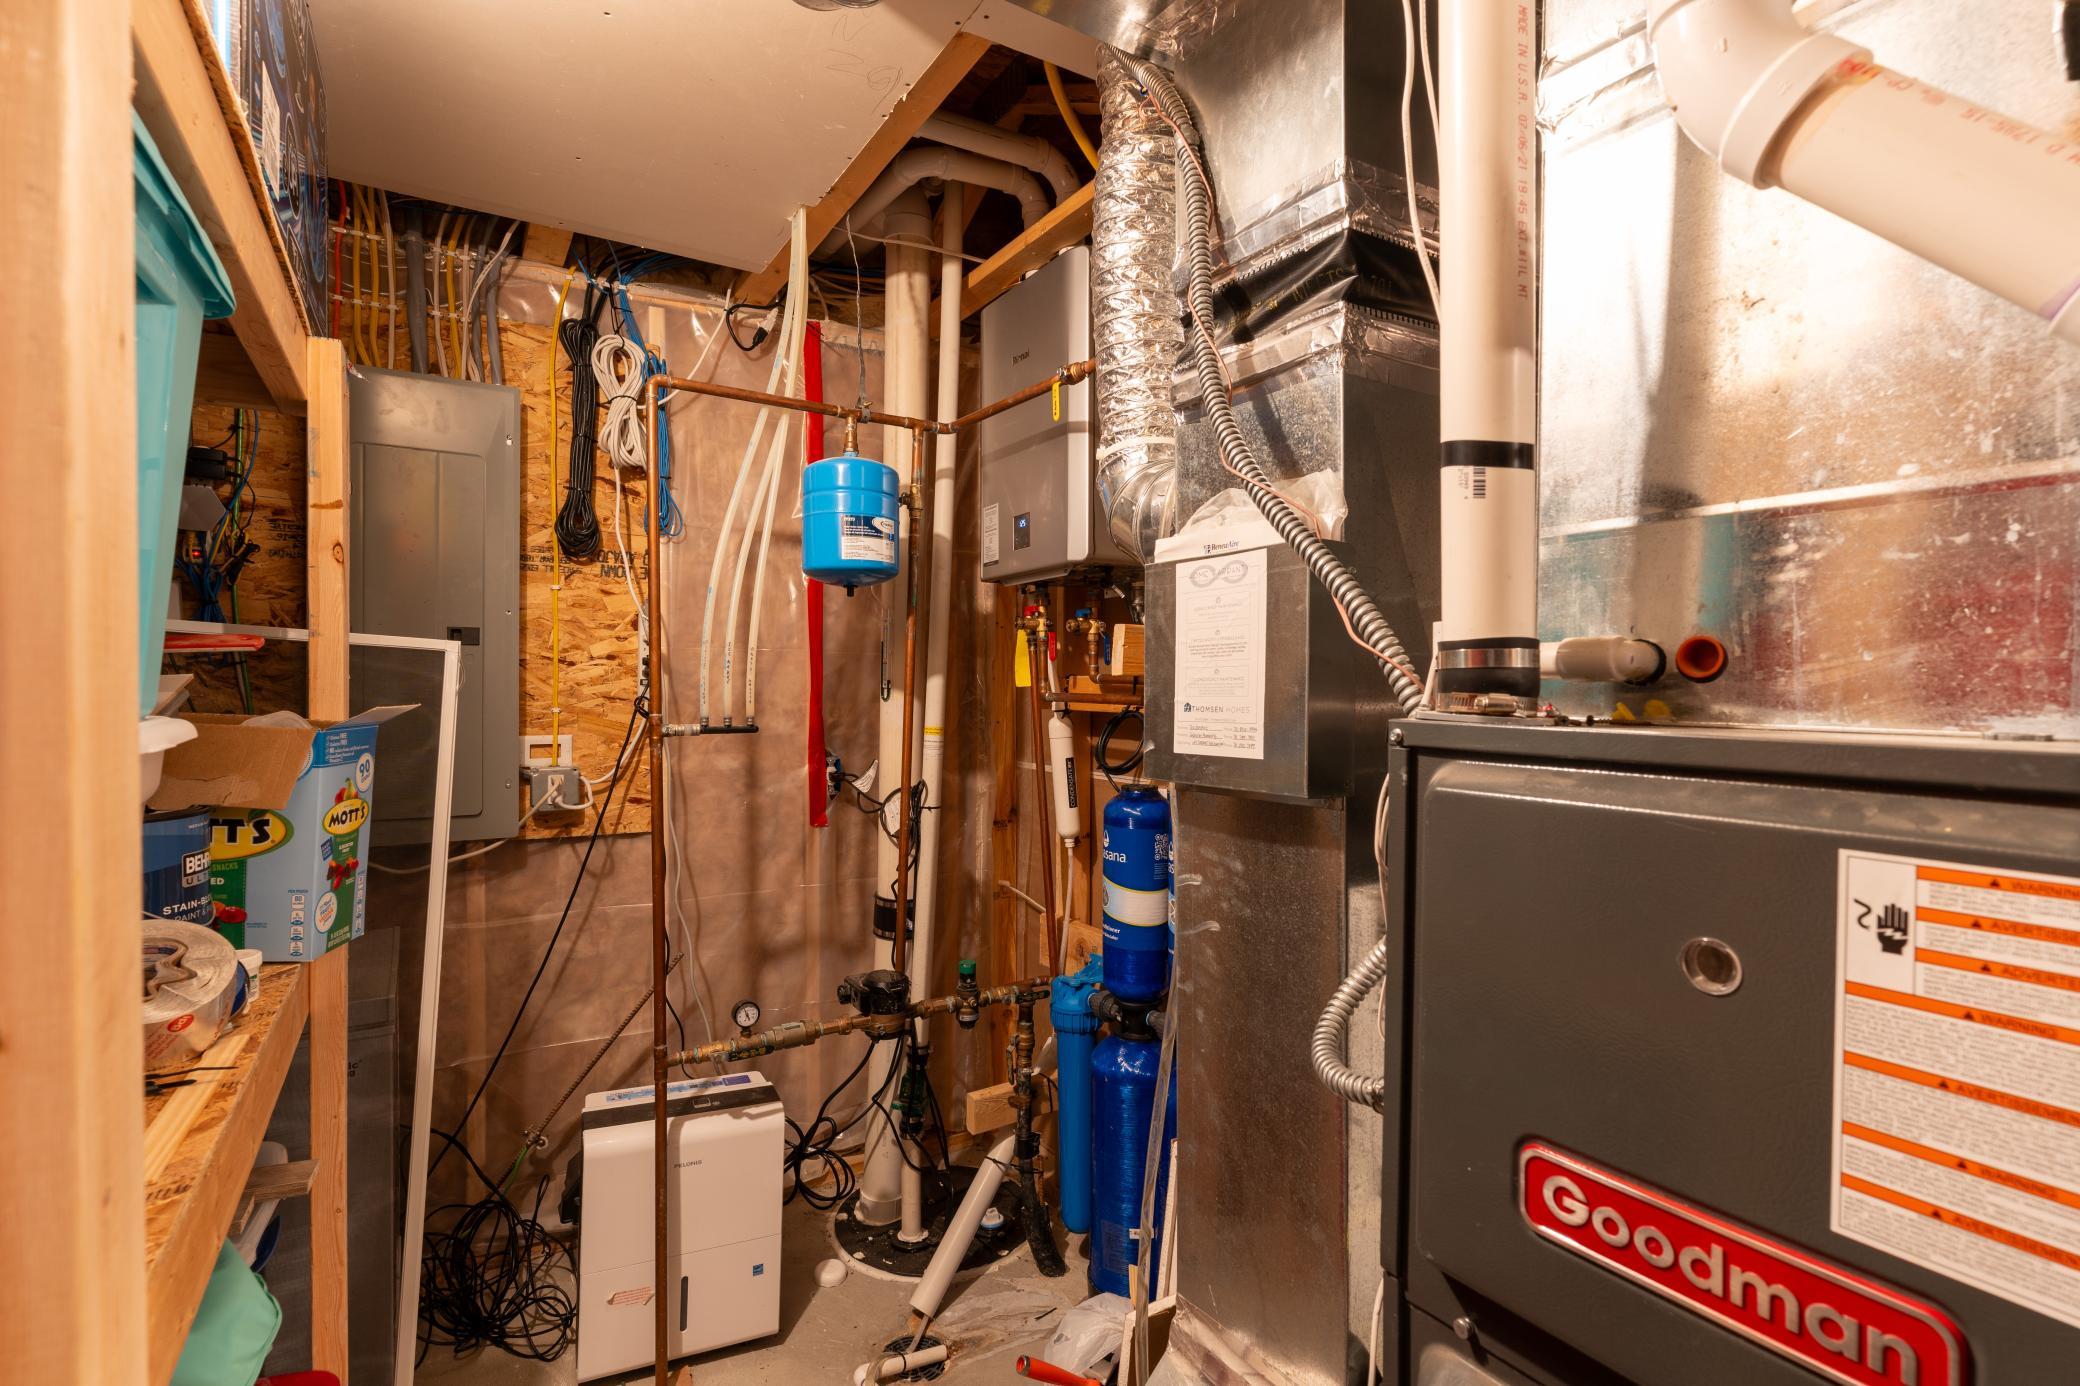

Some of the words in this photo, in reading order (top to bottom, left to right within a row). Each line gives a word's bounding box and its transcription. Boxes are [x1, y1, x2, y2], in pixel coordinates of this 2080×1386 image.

[1517, 4, 1529, 37] MADE
[1517, 42, 1529, 59] IN
[1517, 63, 1529, 105] U.S.A.
[1192, 705, 1224, 714] THOMSEN
[359, 759, 371, 777] 90
[1981, 1013, 2058, 1038] WARNING
[1540, 1172, 1919, 1386] Goodman
